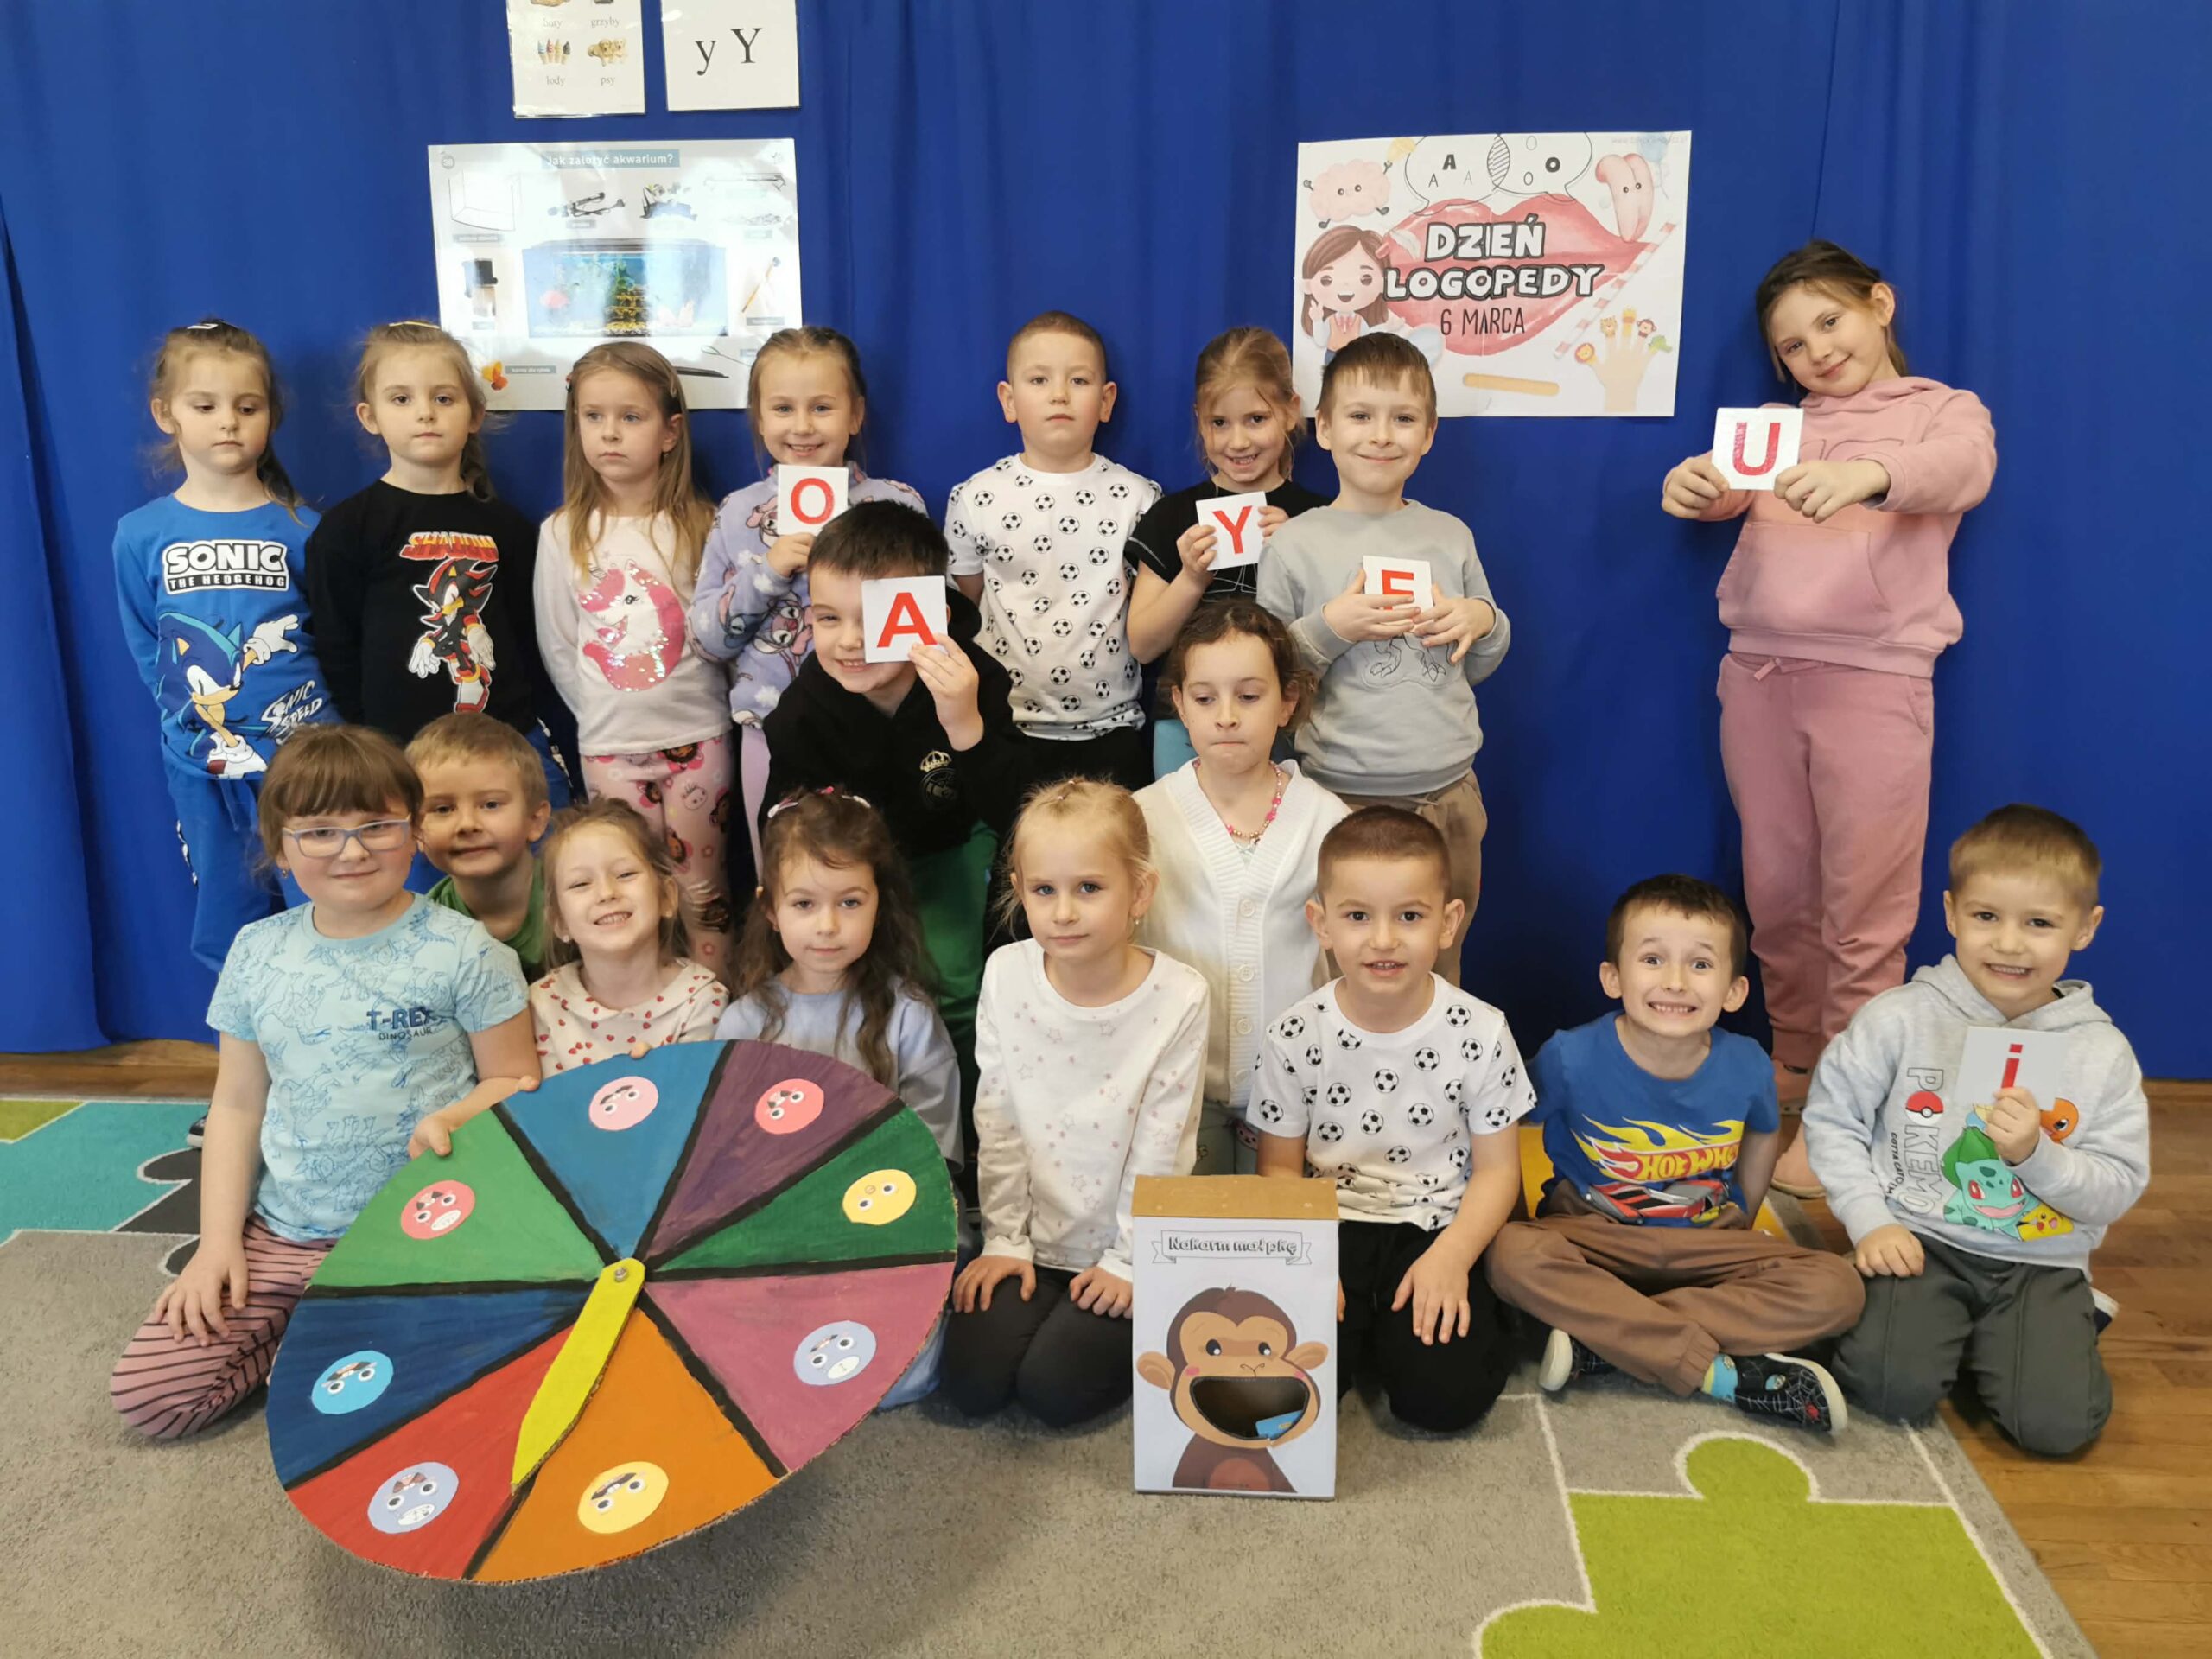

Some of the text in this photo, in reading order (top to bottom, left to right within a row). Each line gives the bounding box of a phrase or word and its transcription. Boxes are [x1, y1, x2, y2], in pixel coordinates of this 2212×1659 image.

[590, 16, 620, 29] grzyby
[695, 28, 762, 76] y Y
[546, 75, 566, 87] lody
[601, 76, 615, 86] psy
[547, 155, 566, 166] Jak
[613, 153, 674, 165] akwarium?
[1442, 154, 1457, 170] A
[1545, 156, 1560, 173] O
[1428, 173, 1439, 188] A
[1523, 171, 1534, 186] O
[1424, 213, 1546, 262] DZIEŃ
[1382, 264, 1605, 302] LOGOPEDY
[1440, 307, 1525, 336] 6 MARCA
[1732, 422, 1781, 476] U
[791, 477, 836, 525] O
[1211, 505, 1253, 555] Y
[165, 543, 285, 575] SONIC
[399, 531, 499, 563] SHADOW
[168, 574, 286, 590] THE HEDGEHOG
[876, 592, 938, 648] A
[366, 1006, 435, 1031] T-REX
[378, 1026, 432, 1040] DINOSAUR
[1634, 1153, 1688, 1181] HOT
[1168, 1236, 1297, 1255] Nakarm małpkę
